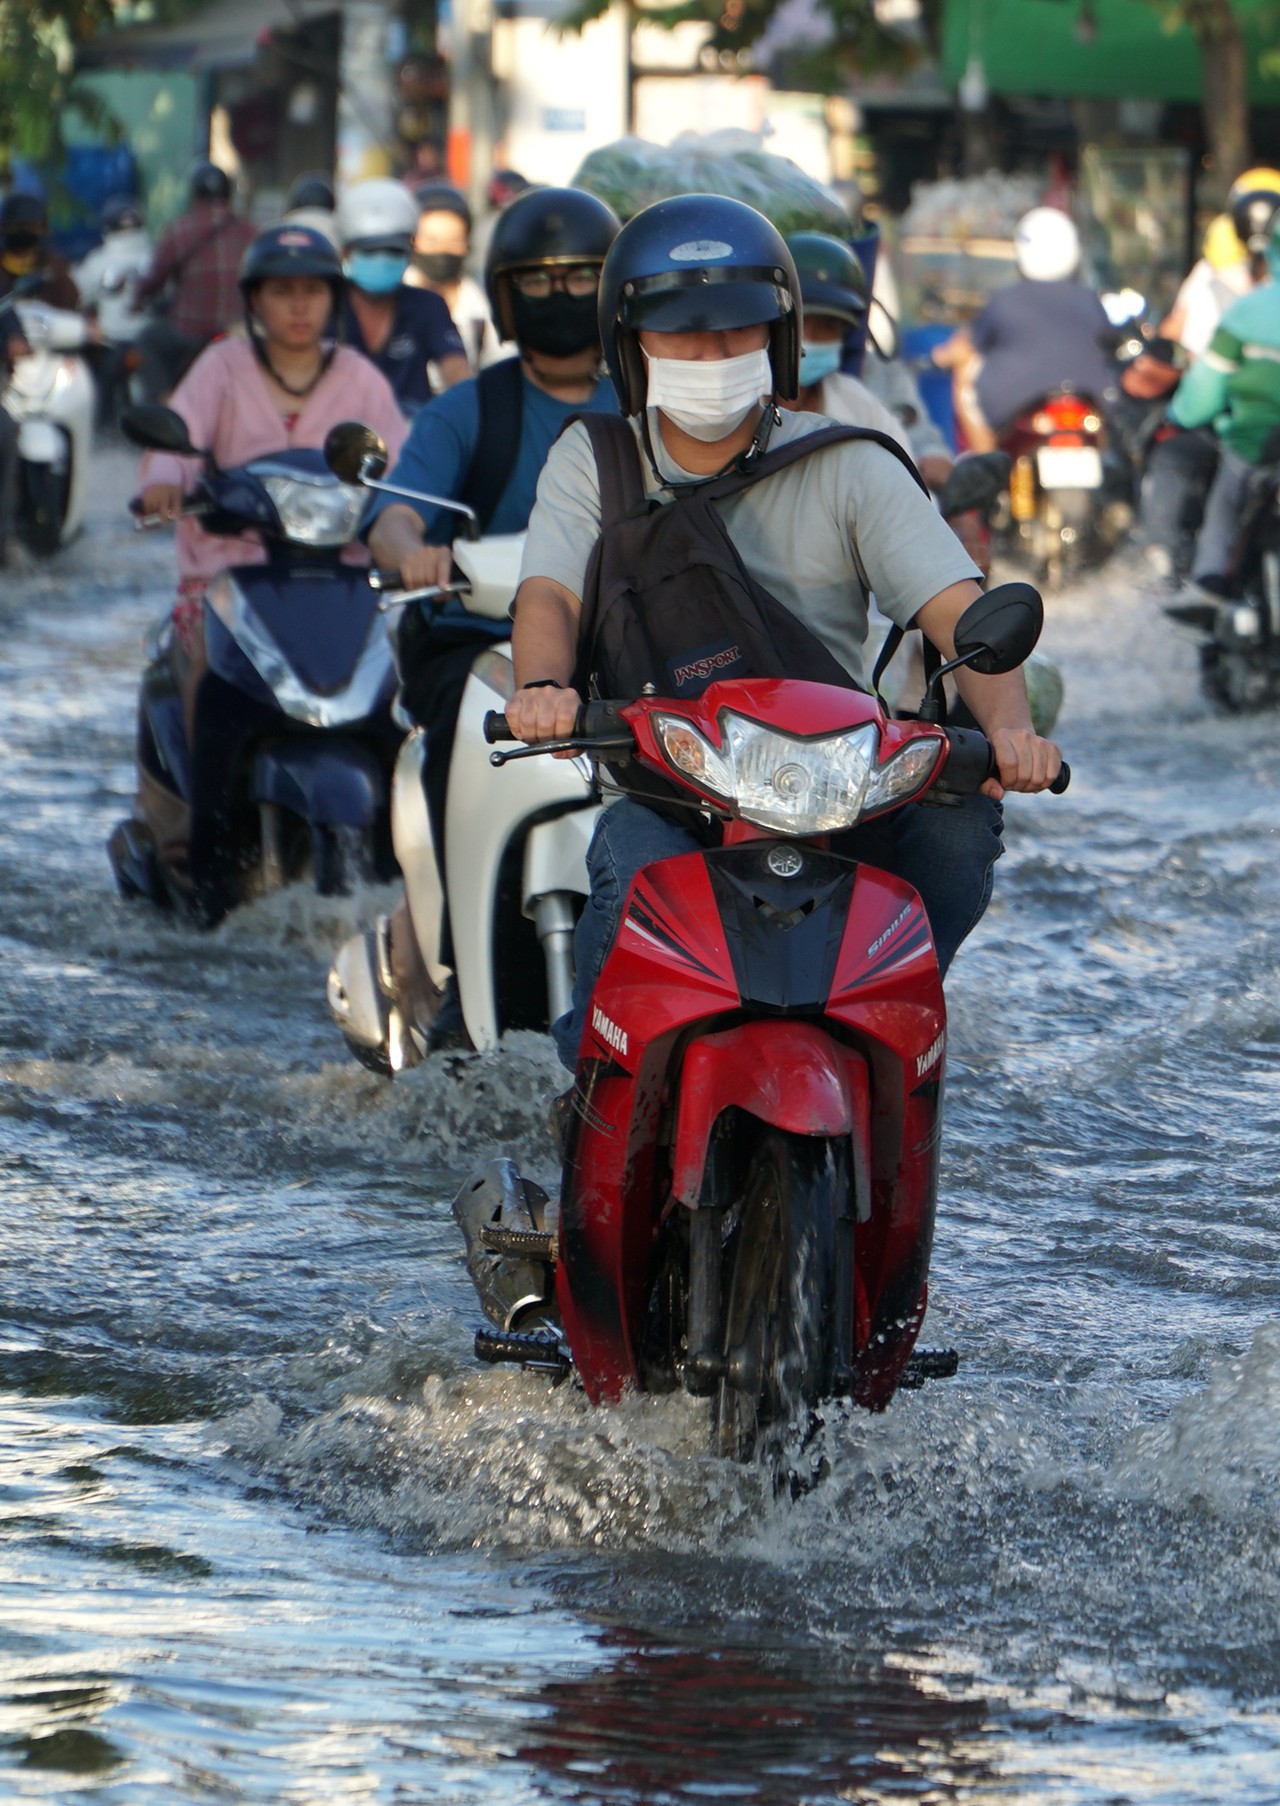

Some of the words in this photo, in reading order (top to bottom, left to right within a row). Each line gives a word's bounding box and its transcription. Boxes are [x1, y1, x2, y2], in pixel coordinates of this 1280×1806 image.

[674, 645, 740, 687] JANSPORT
[867, 904, 911, 959] SIRIUS
[592, 1003, 628, 1056] YAMAHA
